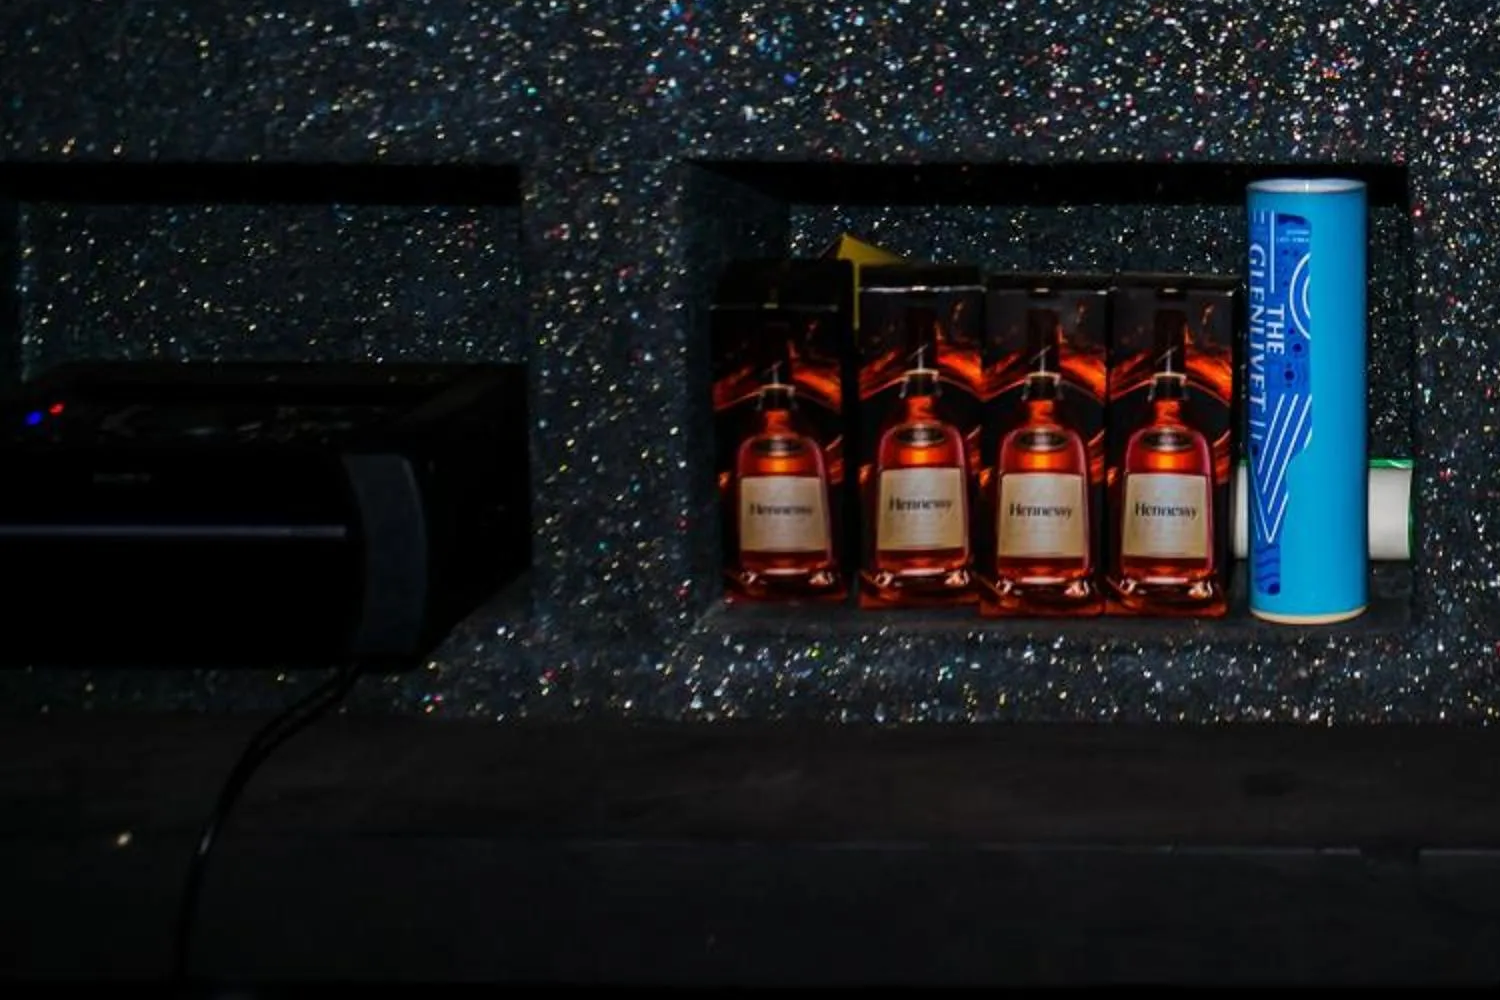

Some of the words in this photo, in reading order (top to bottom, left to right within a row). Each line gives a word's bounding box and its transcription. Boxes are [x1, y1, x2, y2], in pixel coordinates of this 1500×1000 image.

[1247, 242, 1267, 413] GLENLIVET
[1266, 303, 1285, 355] THE
[1009, 502, 1073, 520] Hennessy
[1134, 501, 1197, 520] Hennessy
